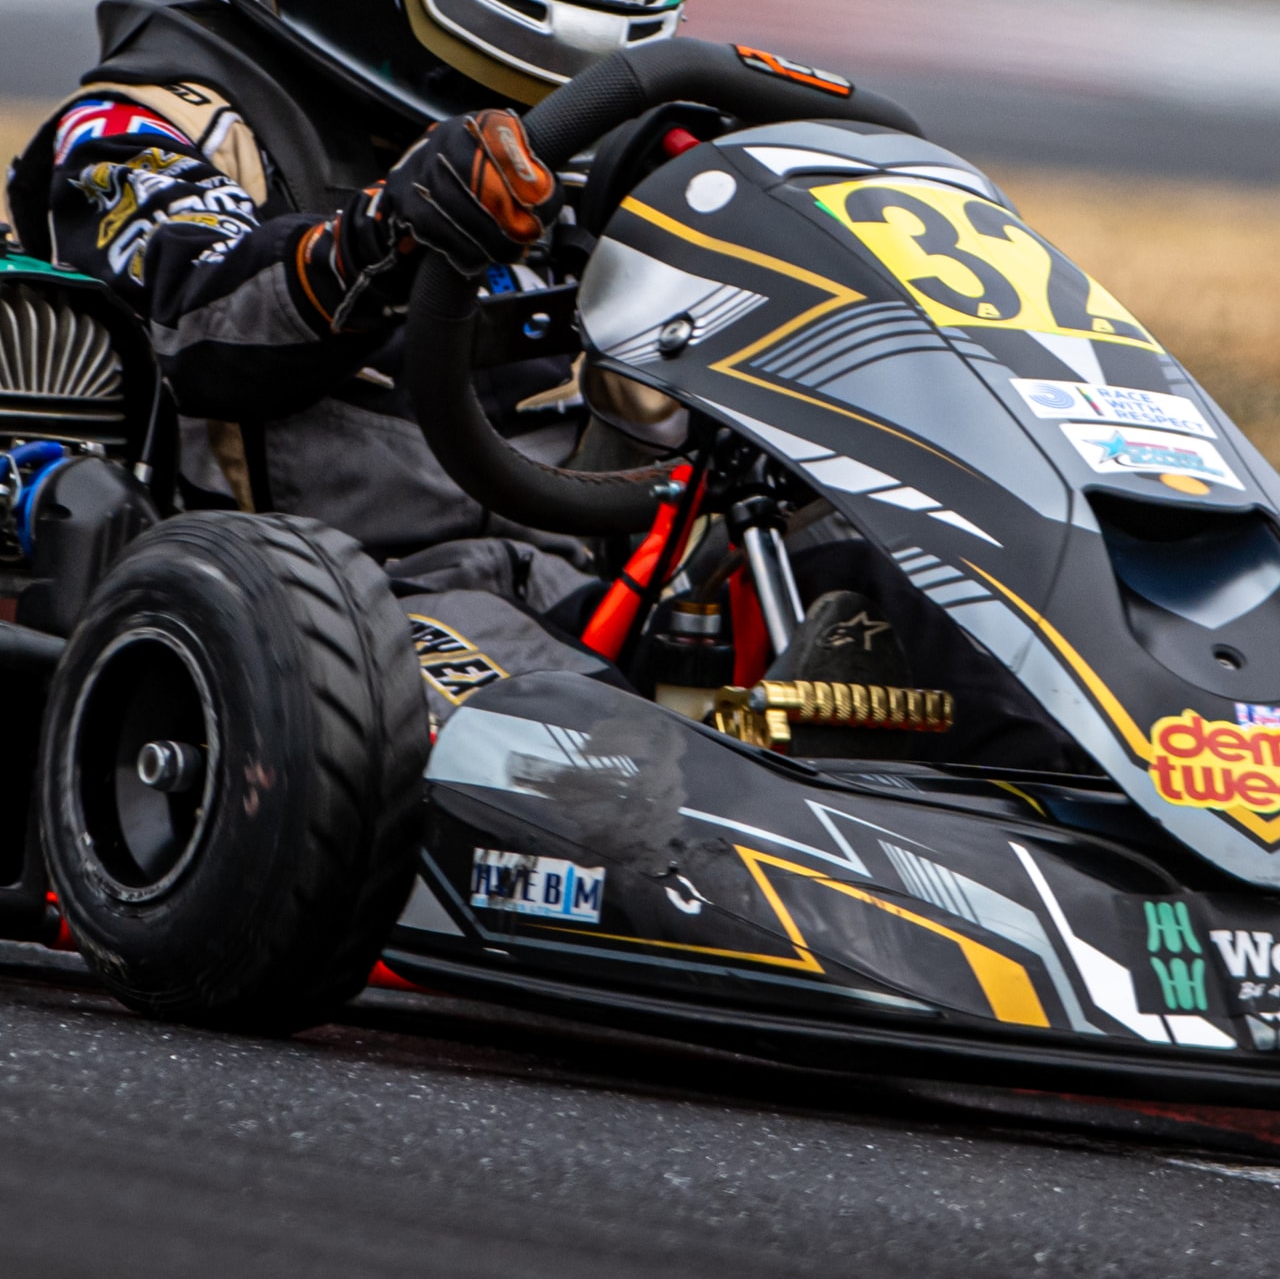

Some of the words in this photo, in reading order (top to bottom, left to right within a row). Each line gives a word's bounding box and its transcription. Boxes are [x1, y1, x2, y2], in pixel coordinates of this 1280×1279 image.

[845, 186, 1155, 345] 32
[1097, 388, 1153, 404] RACE
[1107, 399, 1164, 414] WITH
[1115, 410, 1205, 433] RESPECT
